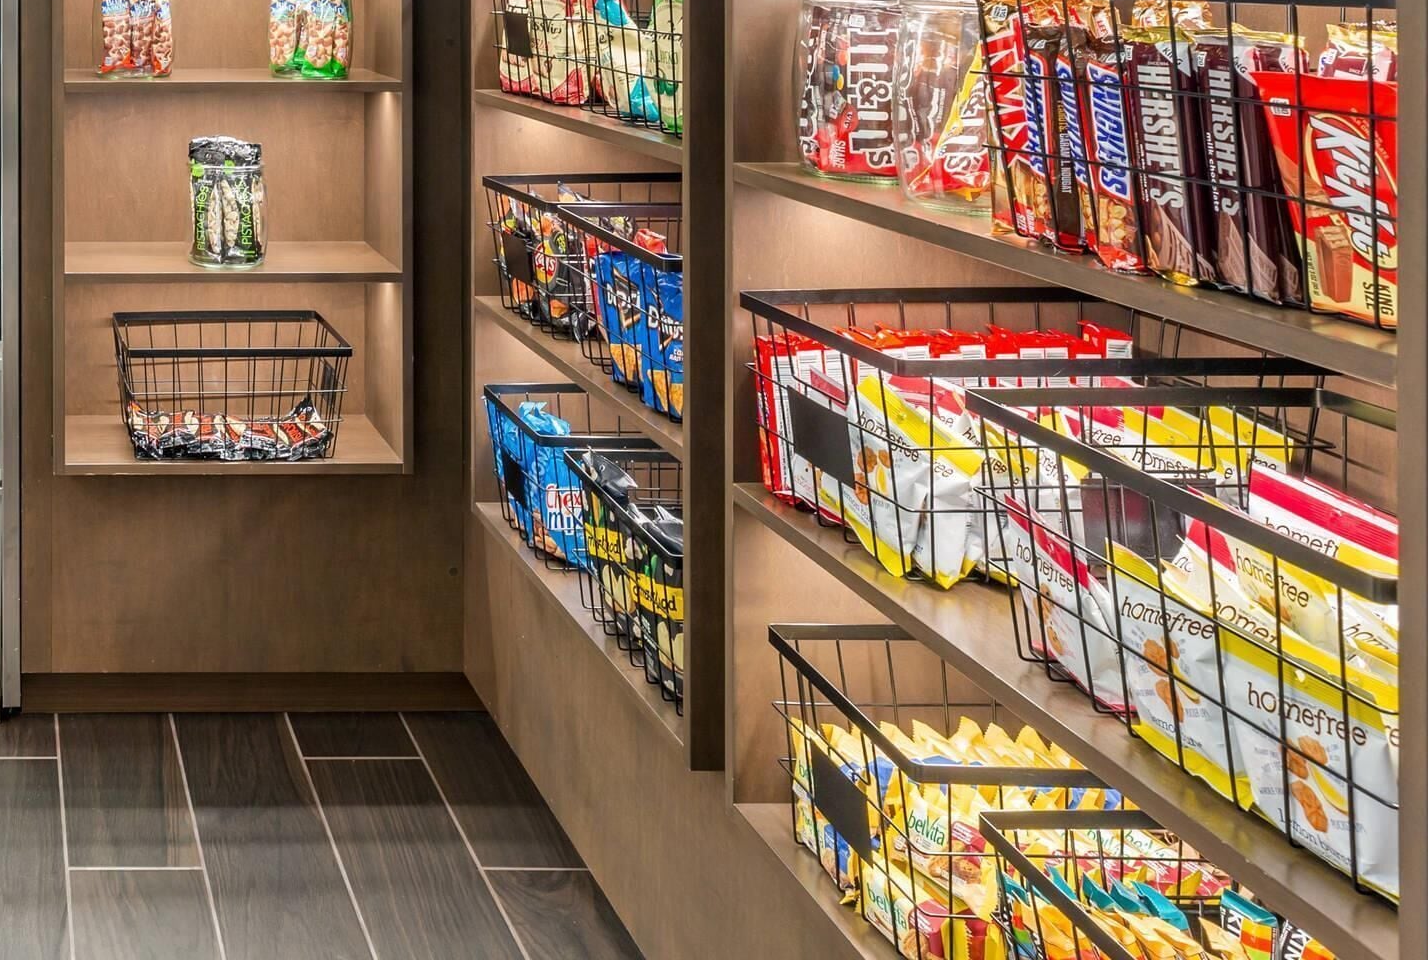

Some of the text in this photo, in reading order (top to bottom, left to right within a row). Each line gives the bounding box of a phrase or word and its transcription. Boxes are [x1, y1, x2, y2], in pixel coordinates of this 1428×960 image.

[1162, 46, 1184, 67] KIG
[1206, 132, 1214, 156] milk
[1061, 167, 1072, 194] NOUGAT
[195, 184, 209, 251] PISTACHIOS
[1379, 284, 1395, 316] KING
[545, 484, 582, 510] Chex
[1235, 547, 1311, 608] homefree
[1121, 595, 1215, 640] homefree
[1247, 681, 1368, 747] homefree
[907, 809, 946, 847] belVita
